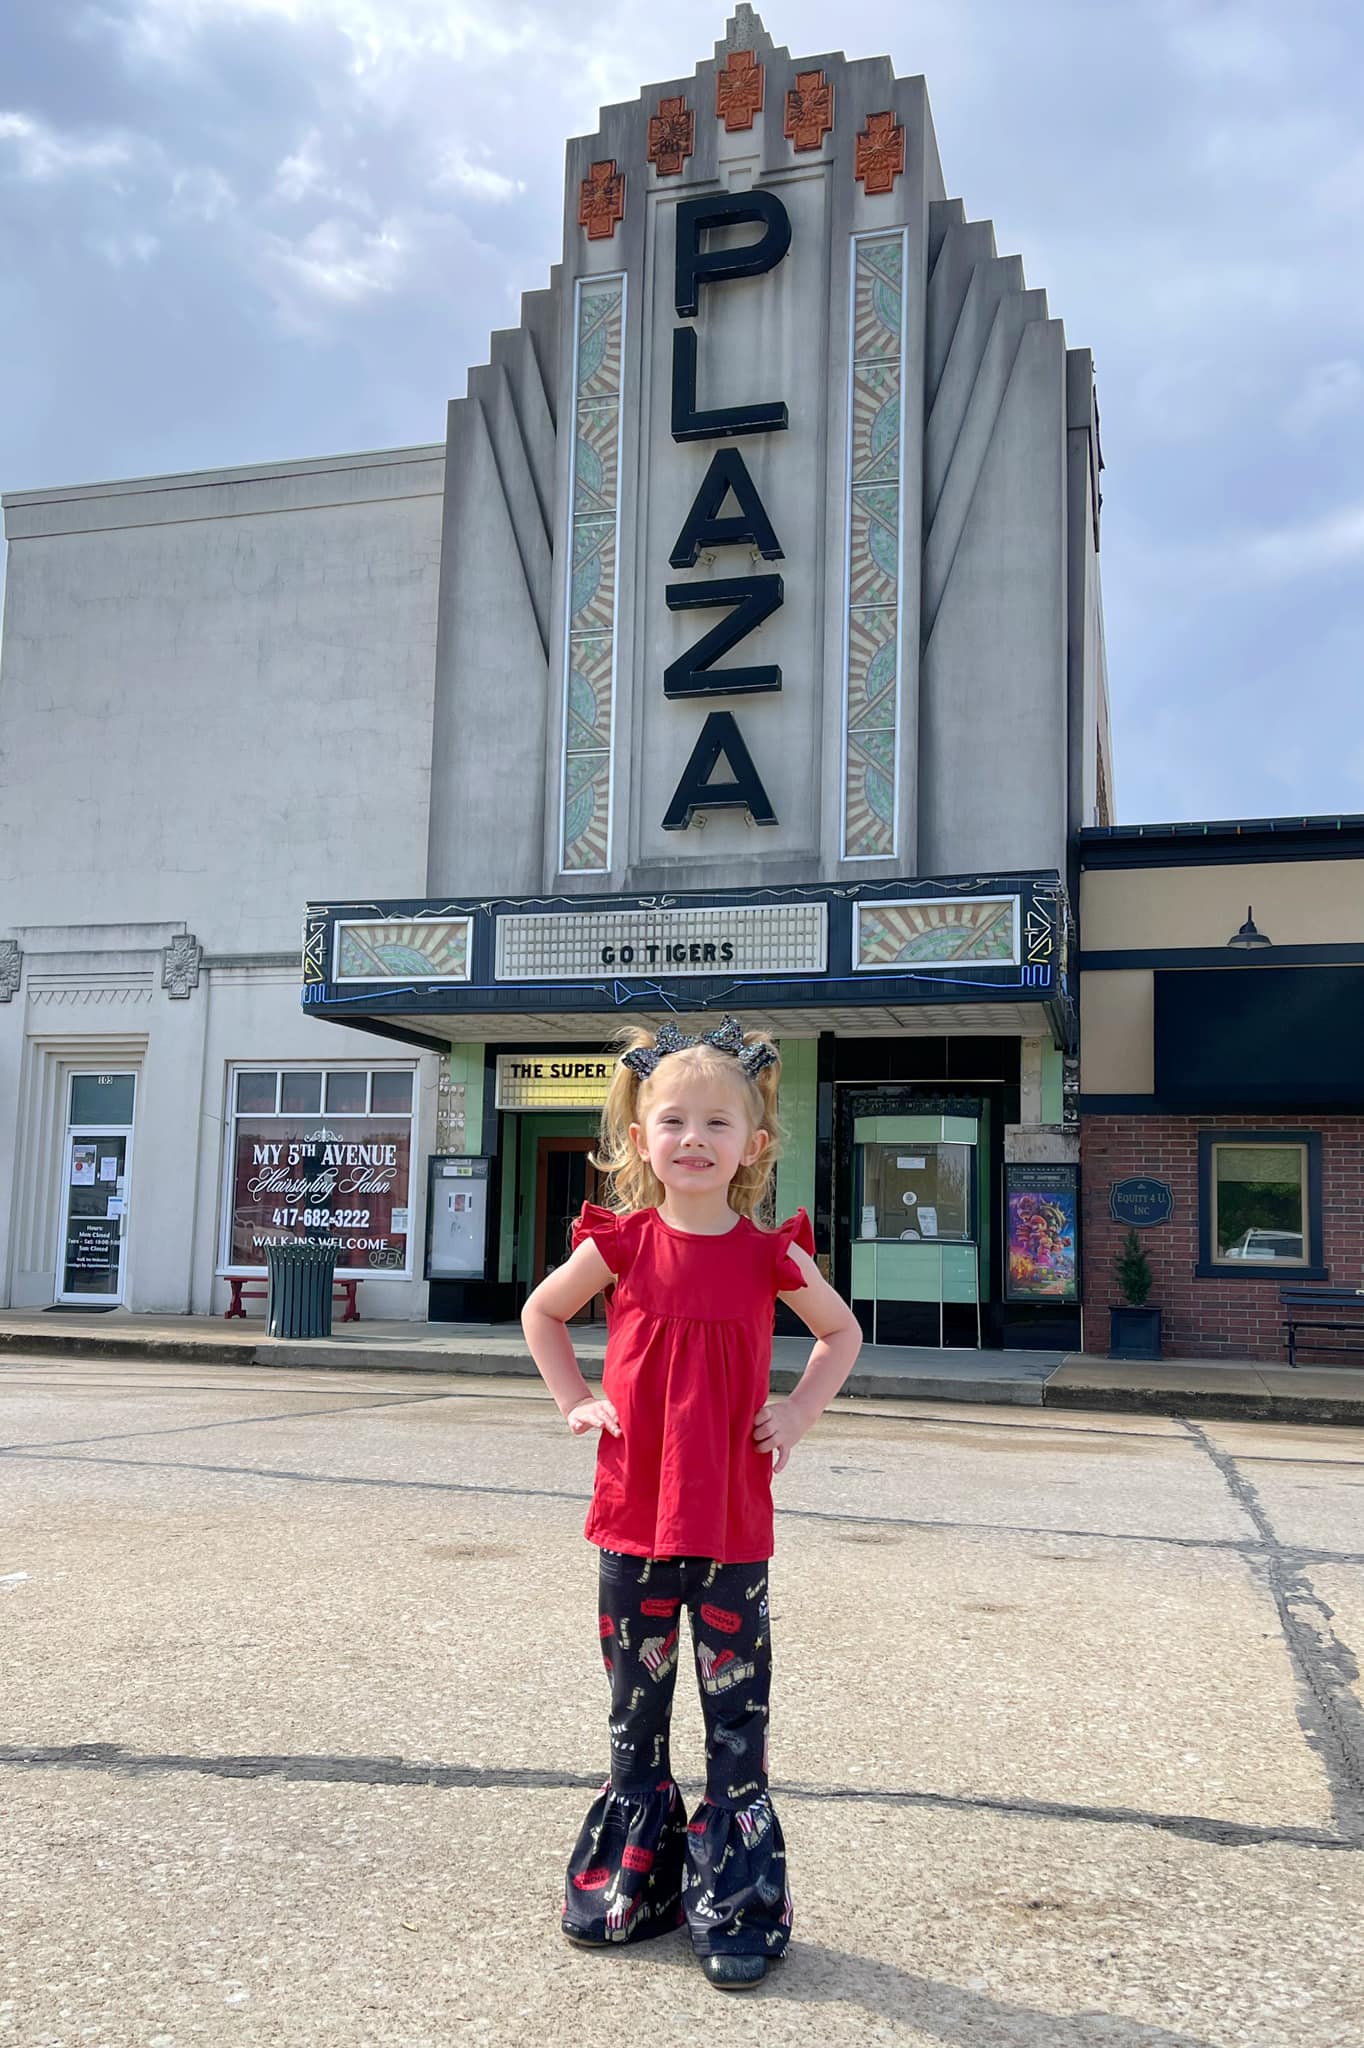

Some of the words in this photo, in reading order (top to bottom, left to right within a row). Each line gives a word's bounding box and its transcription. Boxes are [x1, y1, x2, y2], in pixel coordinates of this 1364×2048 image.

[662, 190, 792, 831] PLAZA
[602, 945, 634, 964] GO
[646, 942, 733, 963] TIGERS
[510, 1064, 543, 1078] THE
[550, 1064, 606, 1078] SUPER
[252, 1144, 283, 1165] MY
[288, 1144, 316, 1165] 5TH
[321, 1144, 396, 1166] AVENUE
[247, 1167, 338, 1203] Hairstyling
[338, 1166, 397, 1194] Salon
[1150, 1192, 1156, 1203] 4
[272, 1208, 370, 1228] 417-682-3222
[252, 1235, 316, 1247] WALK-INS
[318, 1237, 389, 1250] WELCOME
[368, 1251, 404, 1265] OPEN
